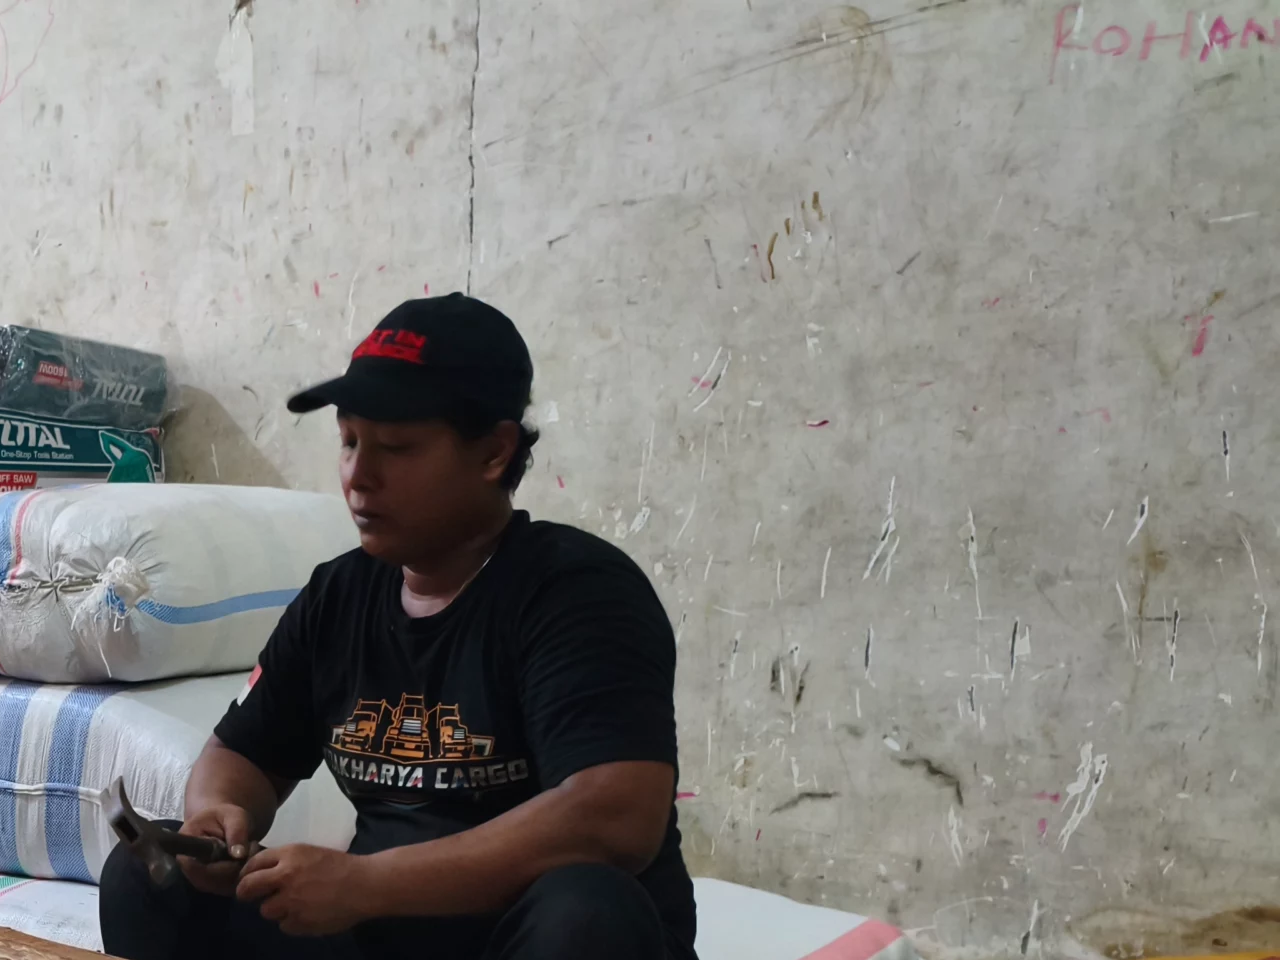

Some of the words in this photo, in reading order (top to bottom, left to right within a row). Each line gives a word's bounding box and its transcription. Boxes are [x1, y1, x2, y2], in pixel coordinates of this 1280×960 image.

[0, 450, 32, 460] One-Stop
[33, 451, 51, 459] Tools
[13, 474, 33, 483] SAW
[434, 759, 529, 789] CARGO
